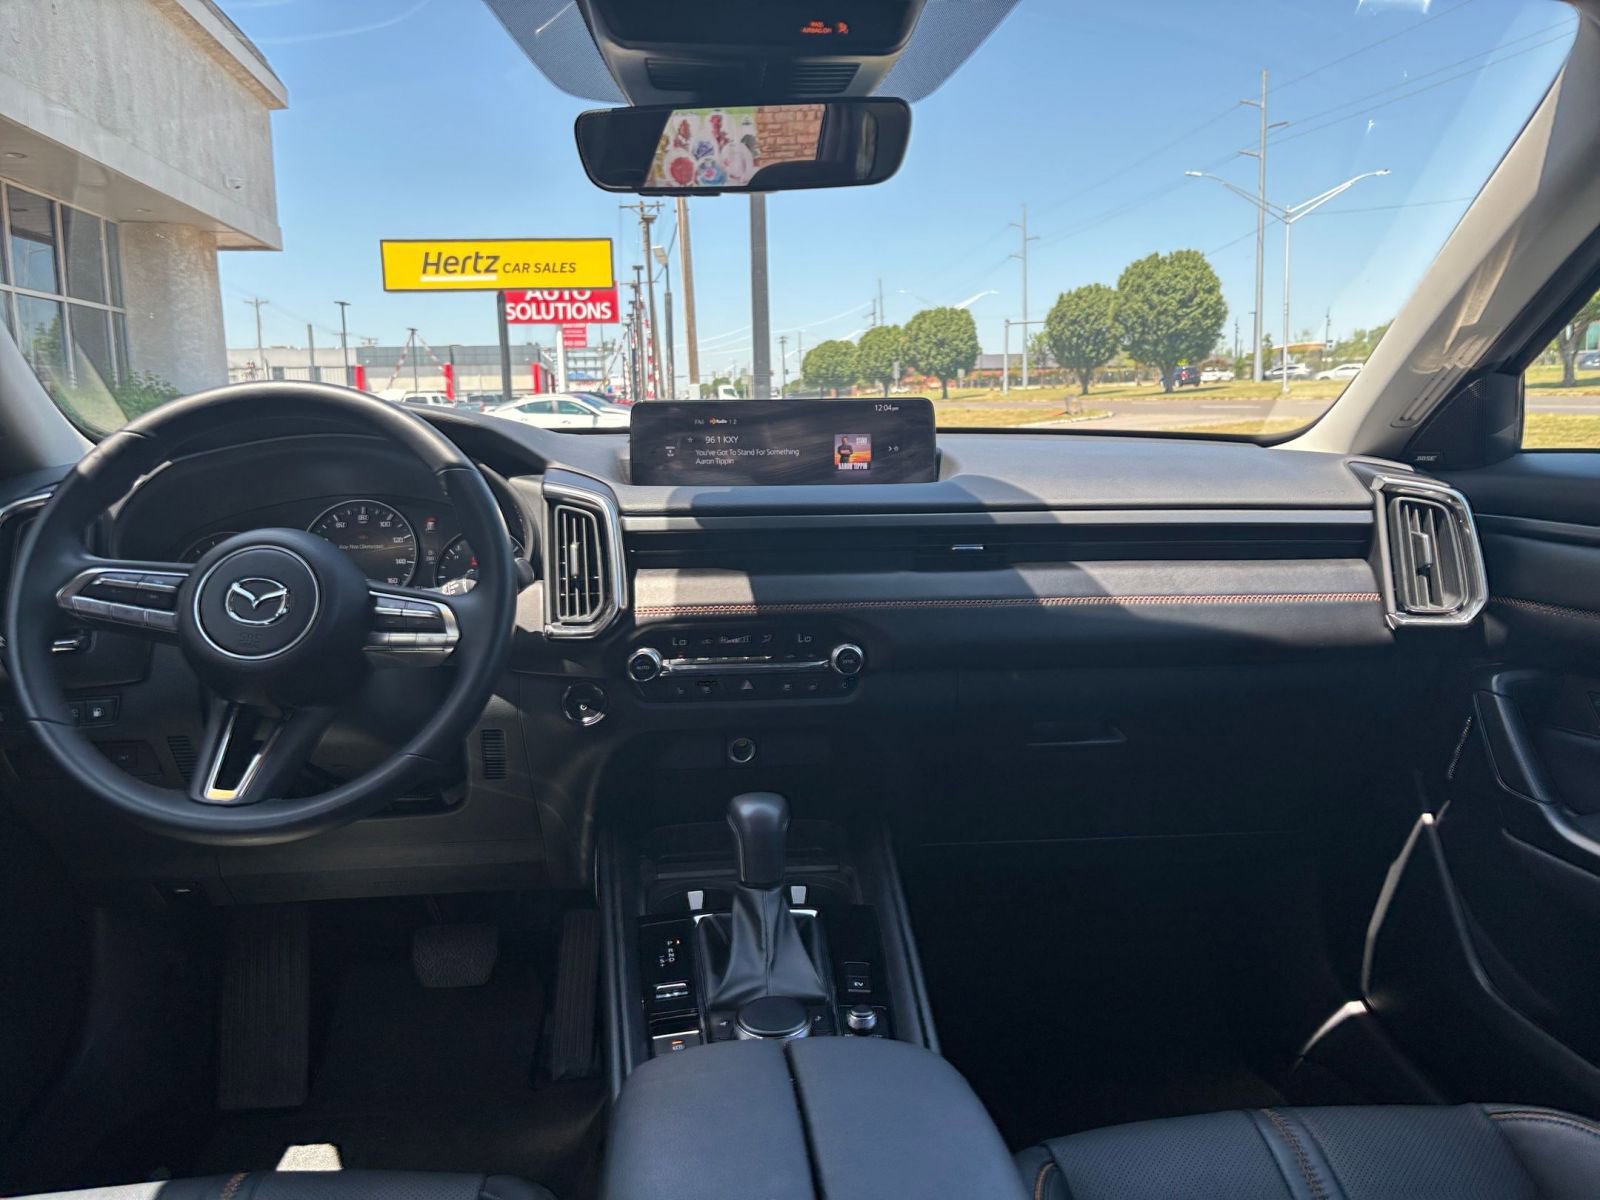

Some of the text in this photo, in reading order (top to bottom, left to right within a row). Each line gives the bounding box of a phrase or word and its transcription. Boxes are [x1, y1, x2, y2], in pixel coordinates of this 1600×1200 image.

[422, 251, 577, 274] Hertz CAR SALES
[506, 302, 612, 321] SOLUTIONS
[766, 448, 799, 457] Something
[716, 458, 734, 466] Tippin
